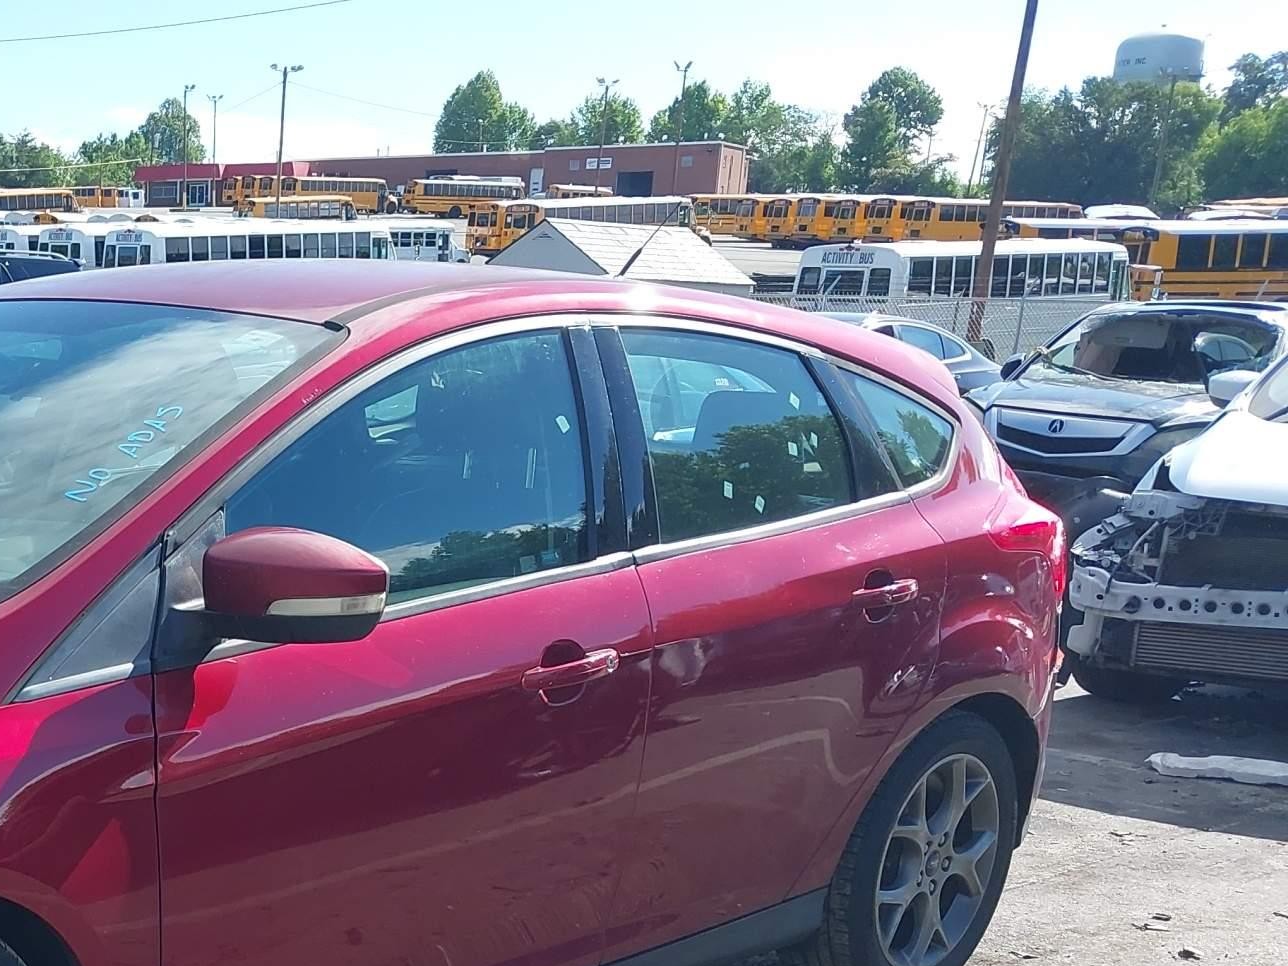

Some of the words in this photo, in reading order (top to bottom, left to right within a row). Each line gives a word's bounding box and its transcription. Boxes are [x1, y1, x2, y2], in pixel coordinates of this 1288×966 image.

[821, 251, 854, 264] ACTIVITY
[858, 252, 875, 265] BUS
[118, 406, 183, 458] ADAS
